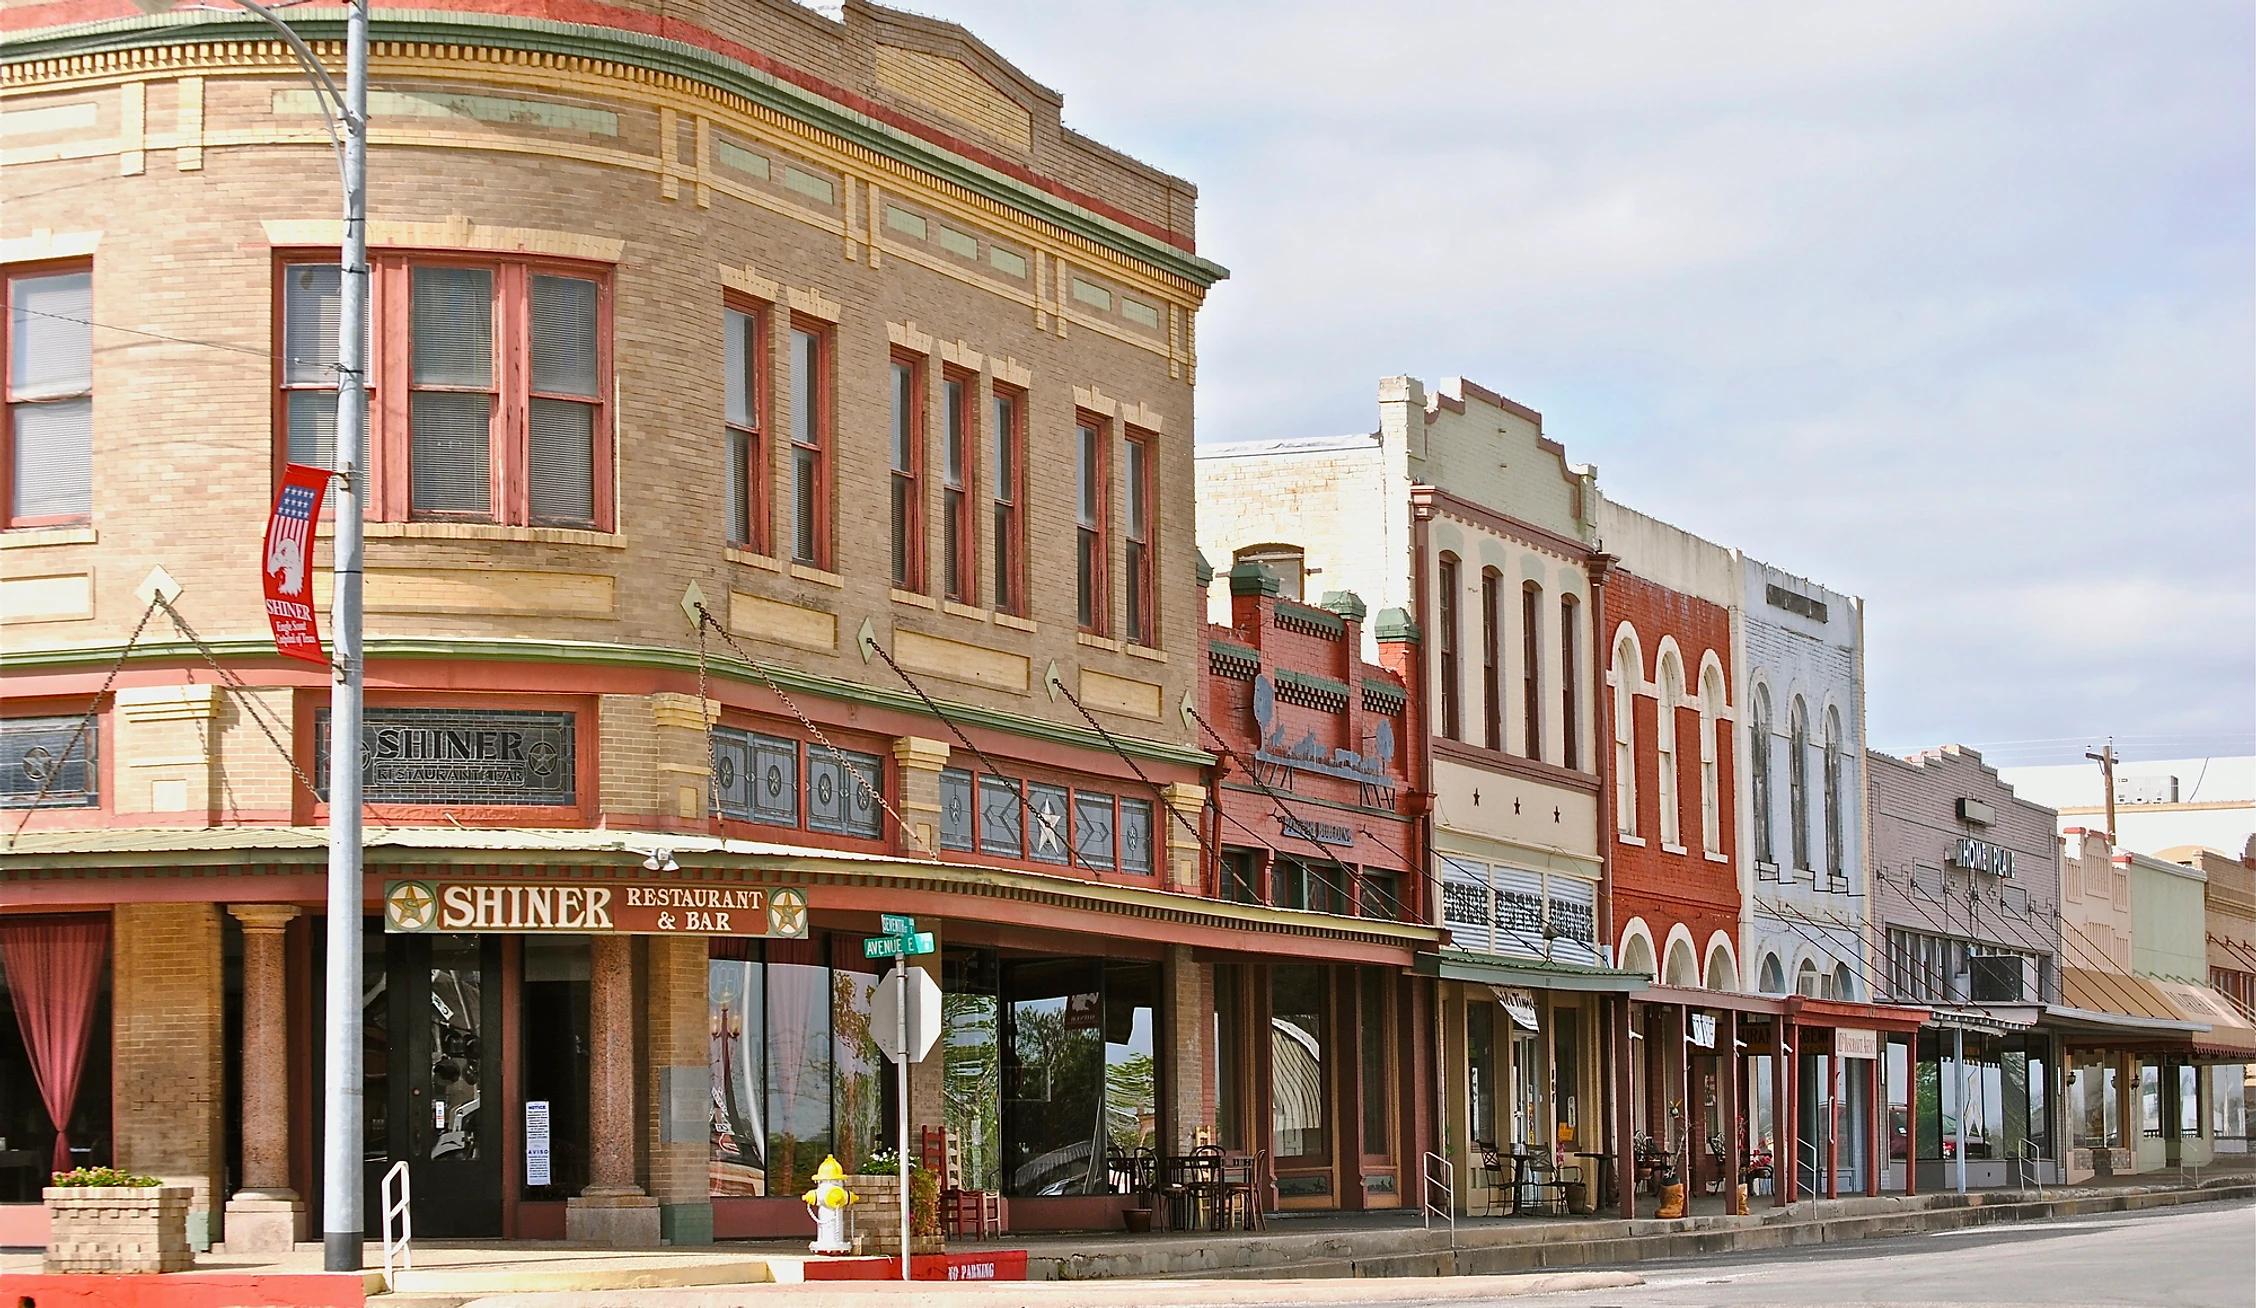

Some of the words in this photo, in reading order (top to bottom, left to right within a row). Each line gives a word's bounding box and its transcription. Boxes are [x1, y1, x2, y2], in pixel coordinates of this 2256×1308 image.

[266, 598, 313, 621] SHINER
[376, 729, 525, 760] SHINER
[1962, 839, 1987, 871] HOME
[443, 885, 614, 928] SHINER
[626, 887, 763, 910] RESTAURANT
[657, 910, 676, 931] &
[685, 911, 732, 931] BAR
[866, 938, 902, 956] AVENUE
[907, 937, 915, 952] E
[948, 1265, 959, 1280] NO
[961, 1262, 995, 1280] PARKING
